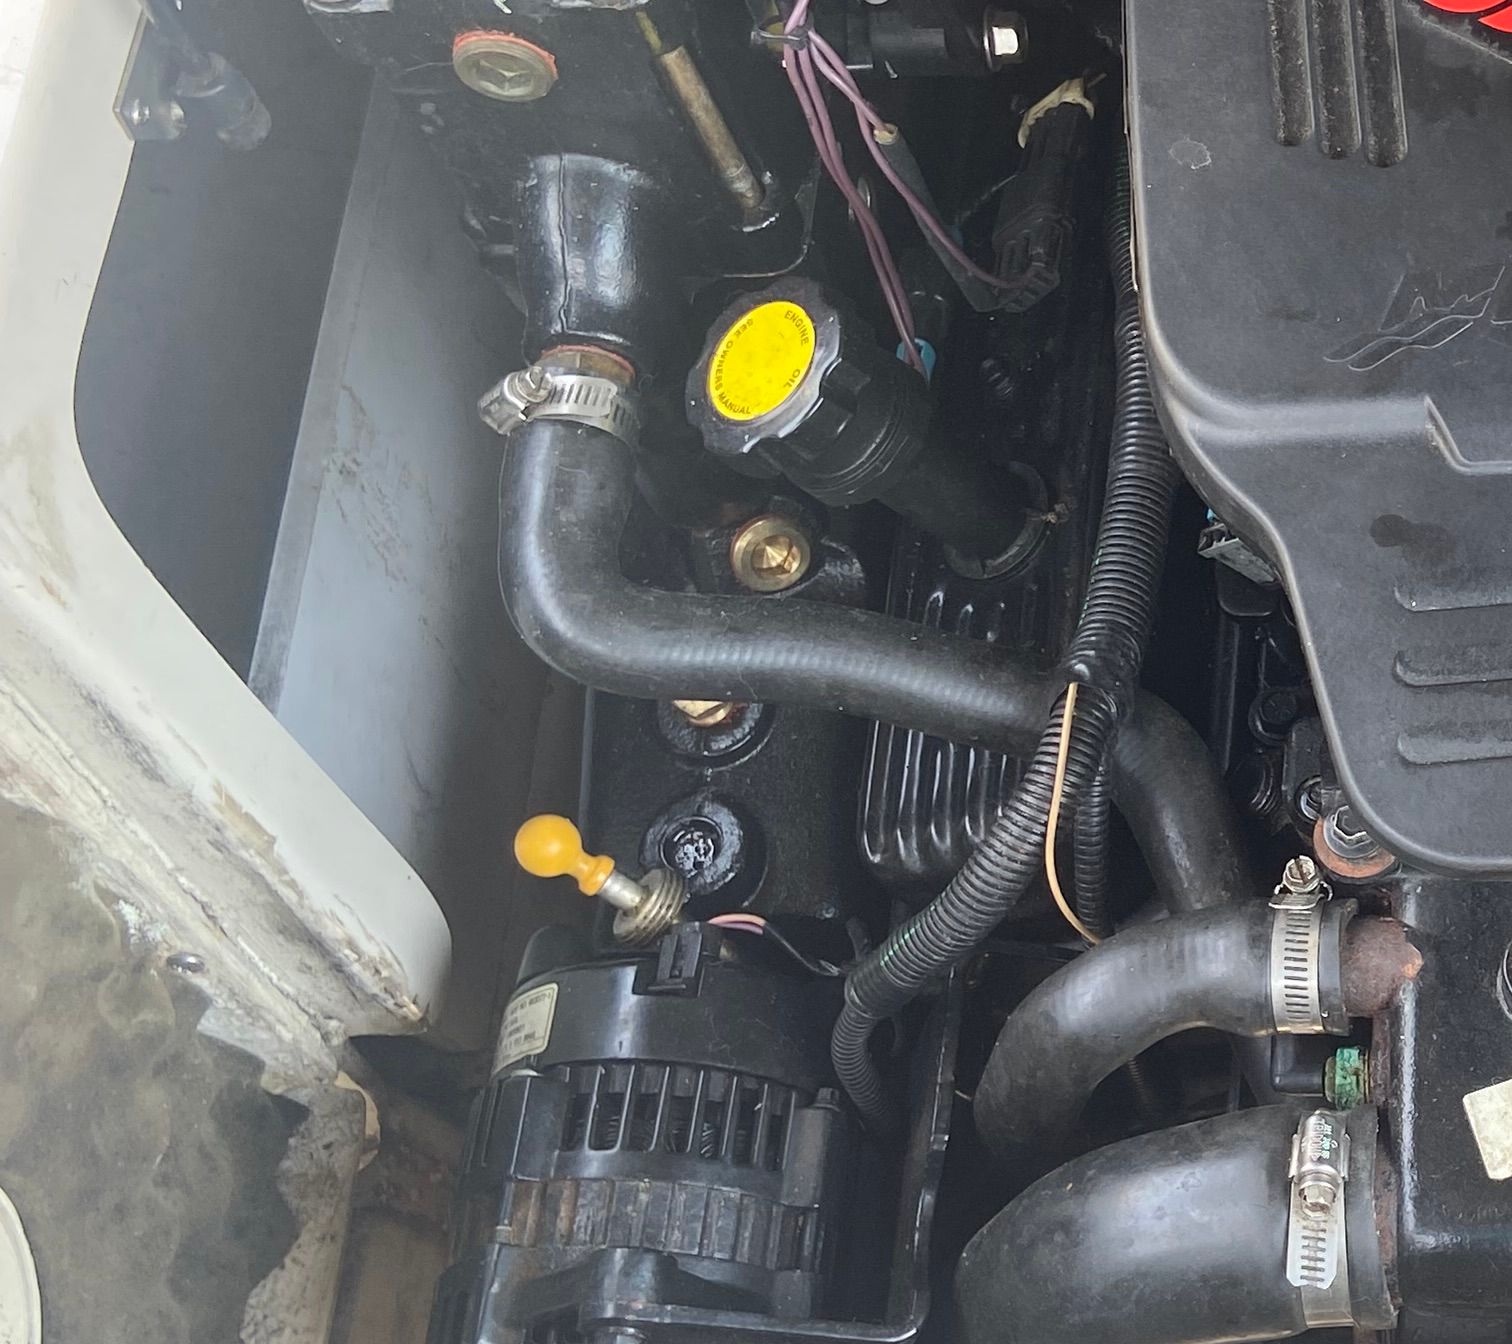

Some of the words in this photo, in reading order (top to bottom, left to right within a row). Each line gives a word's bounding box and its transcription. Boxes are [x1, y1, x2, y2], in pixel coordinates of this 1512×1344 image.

[784, 309, 810, 347] ENGINE
[714, 340, 735, 392] OWNERS
[784, 368, 801, 389] OIL
[718, 392, 752, 416] MANUAL
